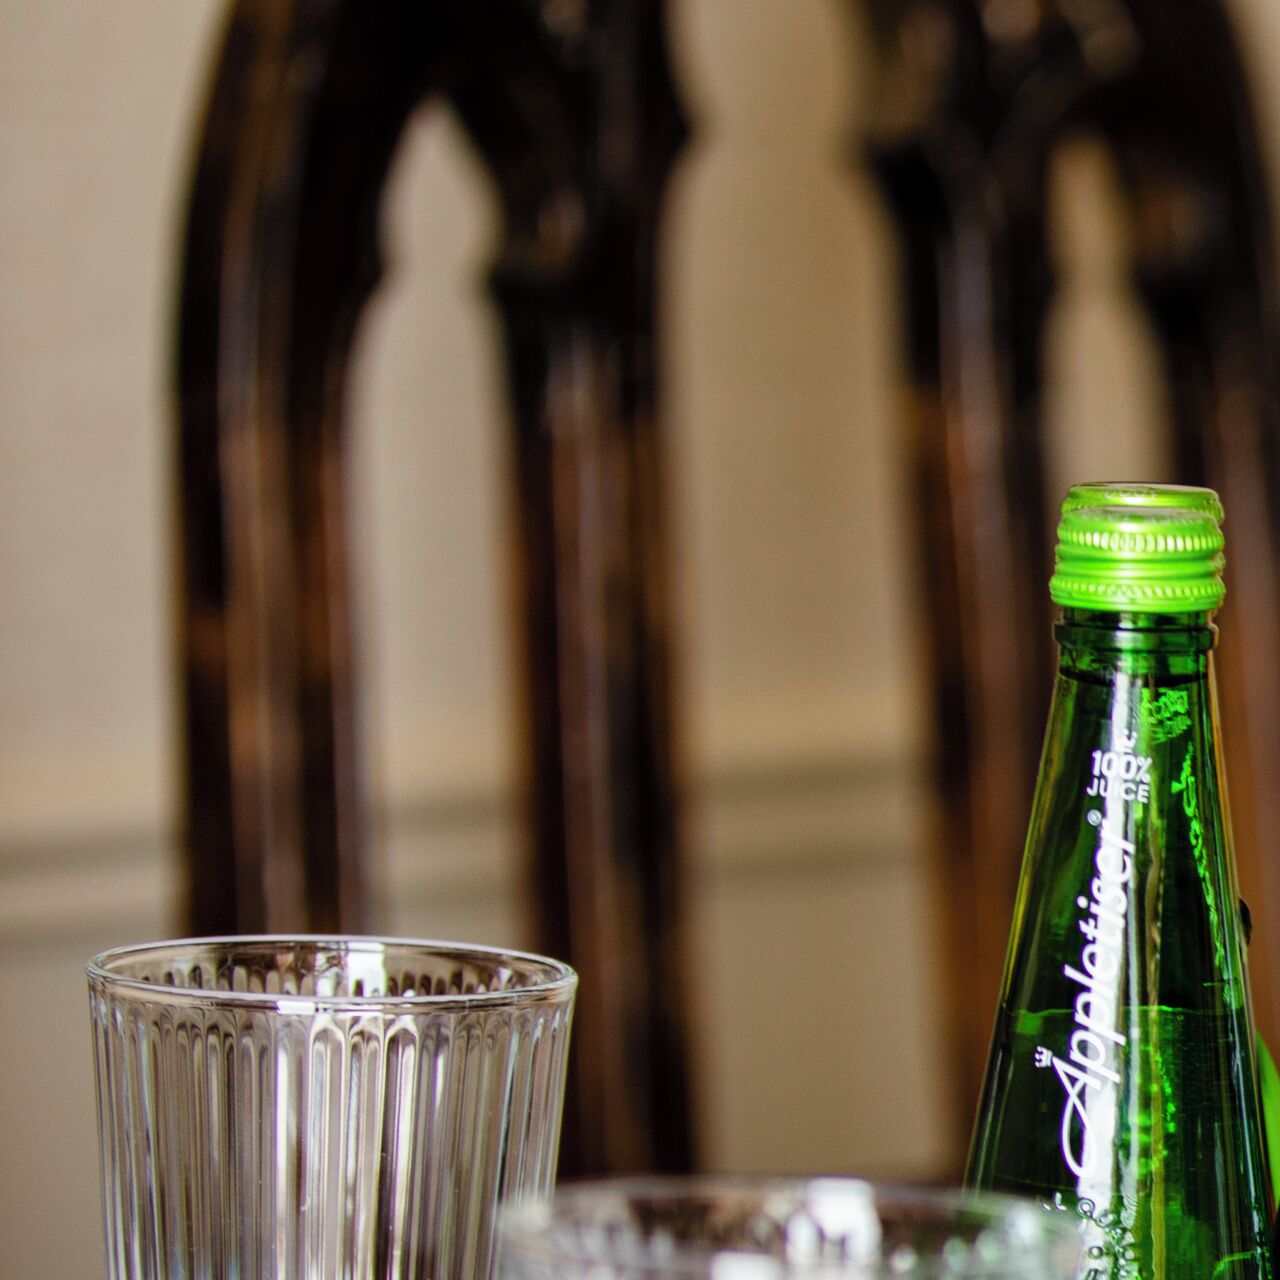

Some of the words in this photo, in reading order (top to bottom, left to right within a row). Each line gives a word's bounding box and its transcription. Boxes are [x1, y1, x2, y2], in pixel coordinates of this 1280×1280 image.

[1092, 749, 1152, 783] 100%
[1086, 777, 1149, 803] JUICE
[1052, 819, 1135, 1177] Appletiser
